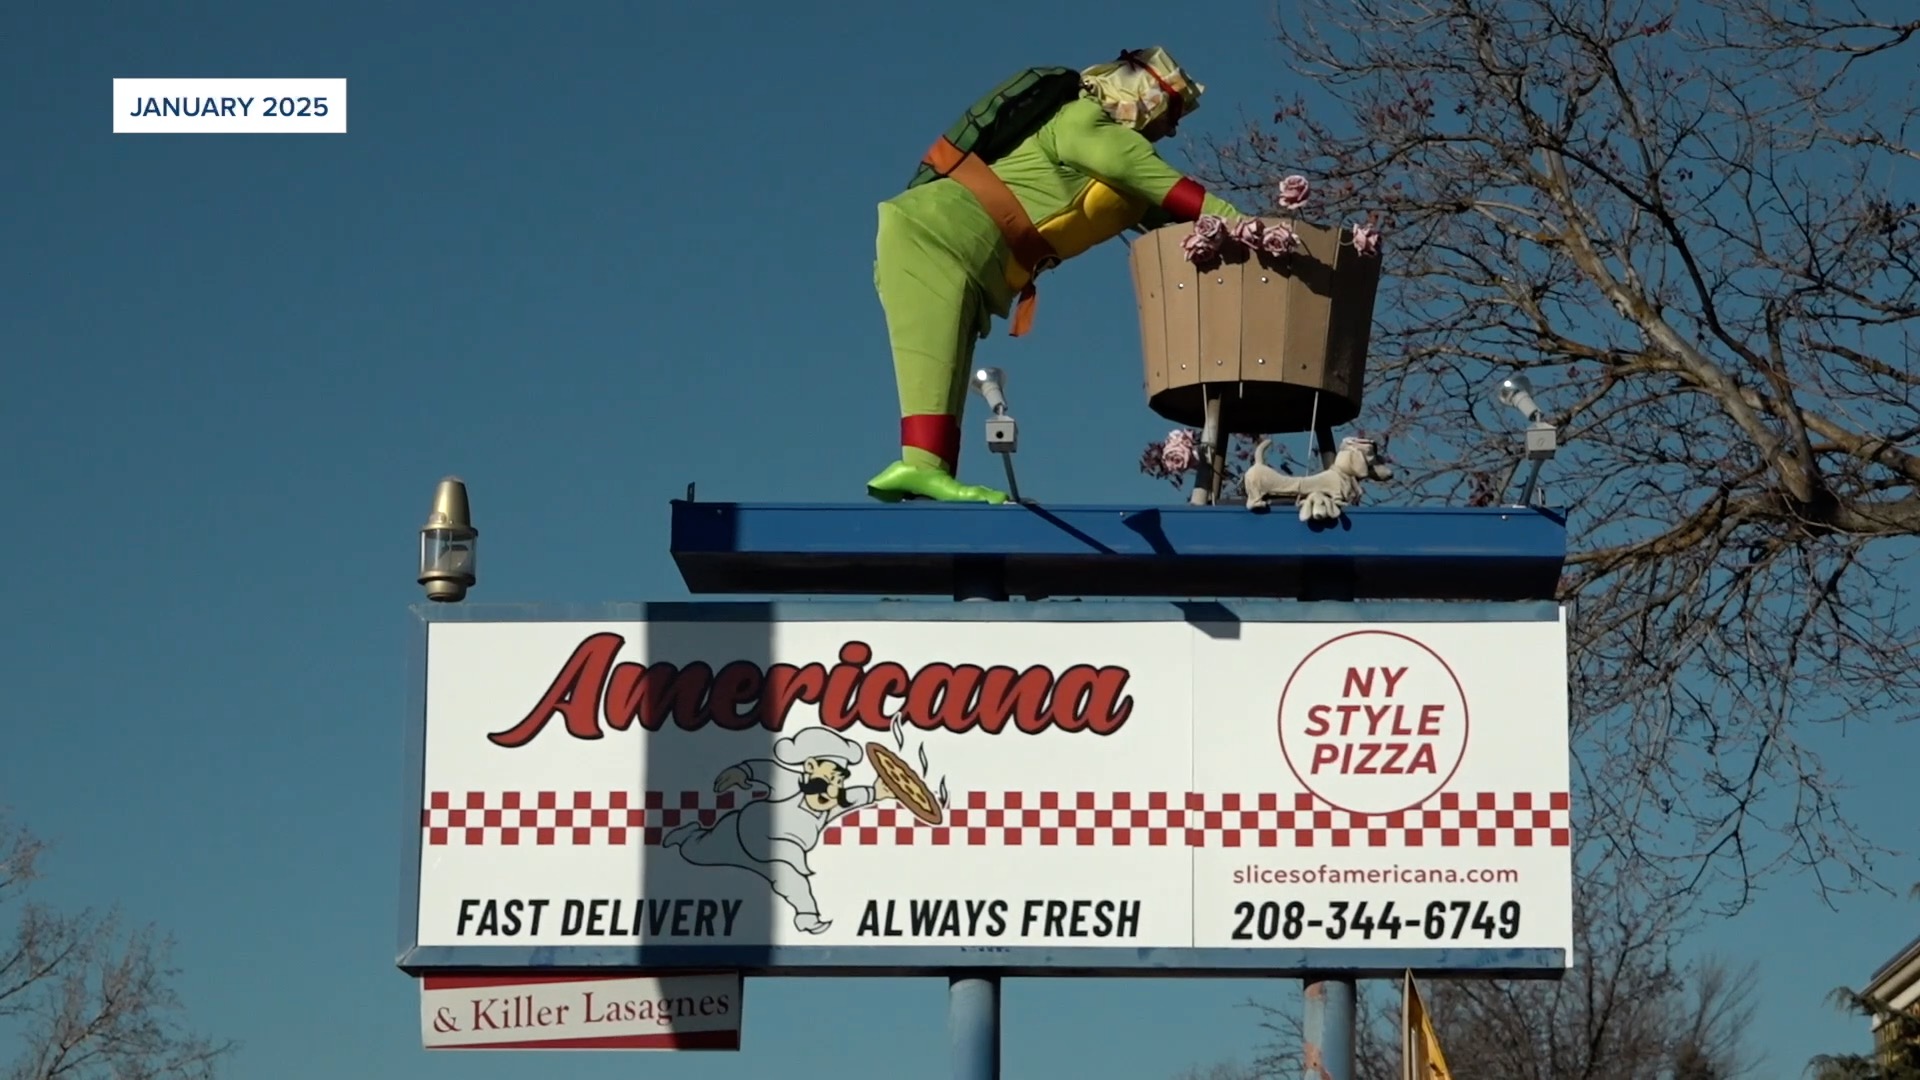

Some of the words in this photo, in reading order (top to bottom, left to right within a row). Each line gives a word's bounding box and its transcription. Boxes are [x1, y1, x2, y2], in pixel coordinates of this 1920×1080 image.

[487, 632, 1133, 748] Americana
[1342, 667, 1408, 698] NY
[1304, 704, 1445, 737] STYLE
[1310, 743, 1437, 775] PIZZA
[1233, 864, 1519, 884] slicesofamericana.com
[456, 899, 549, 936] FAST
[561, 899, 743, 936] DELIVERY
[857, 899, 1008, 937] ALWAYS
[1020, 899, 1141, 937] FRESH
[1231, 900, 1521, 940] 208-344-6749
[433, 1007, 461, 1033] &
[471, 995, 570, 1031] Killer
[582, 991, 730, 1027] Lasagnes
